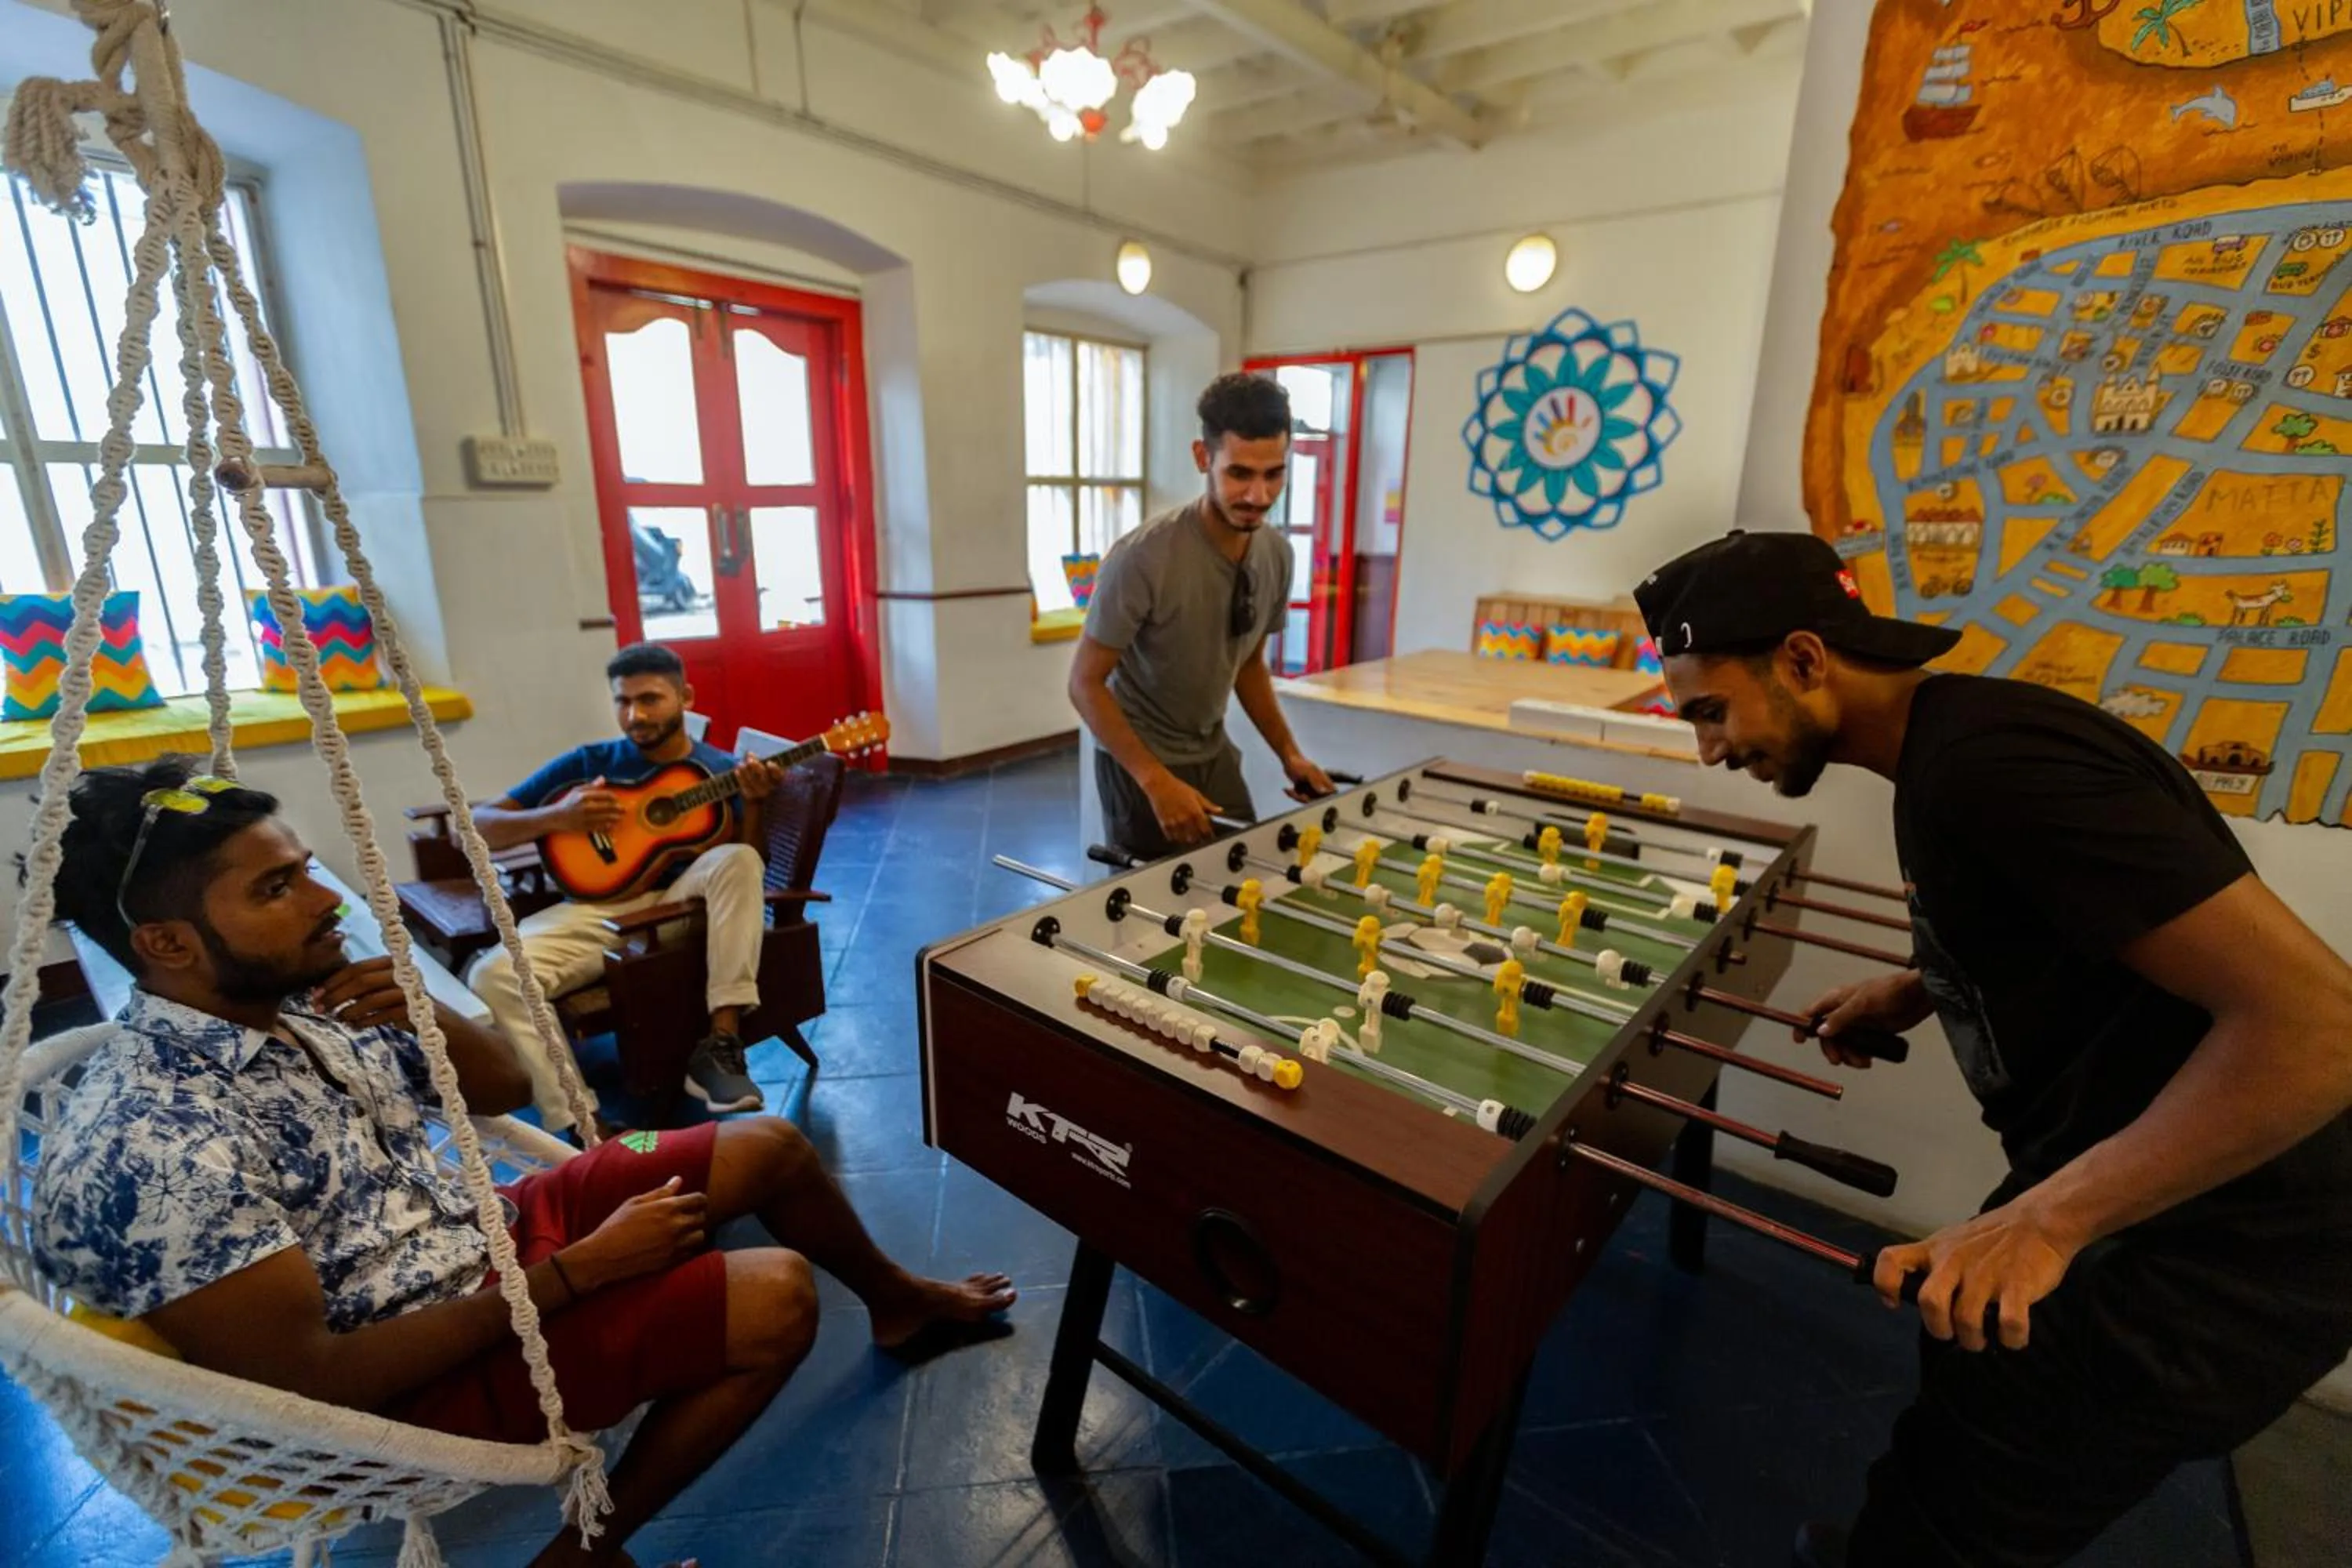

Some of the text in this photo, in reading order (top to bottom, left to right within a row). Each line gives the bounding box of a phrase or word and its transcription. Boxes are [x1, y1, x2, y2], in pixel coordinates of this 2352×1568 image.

[2292, 0, 2352, 33] VIP
[2118, 220, 2213, 249] RIVER ROAD
[2205, 478, 2331, 513] MATTA
[2216, 628, 2331, 645] PALACE ROAD
